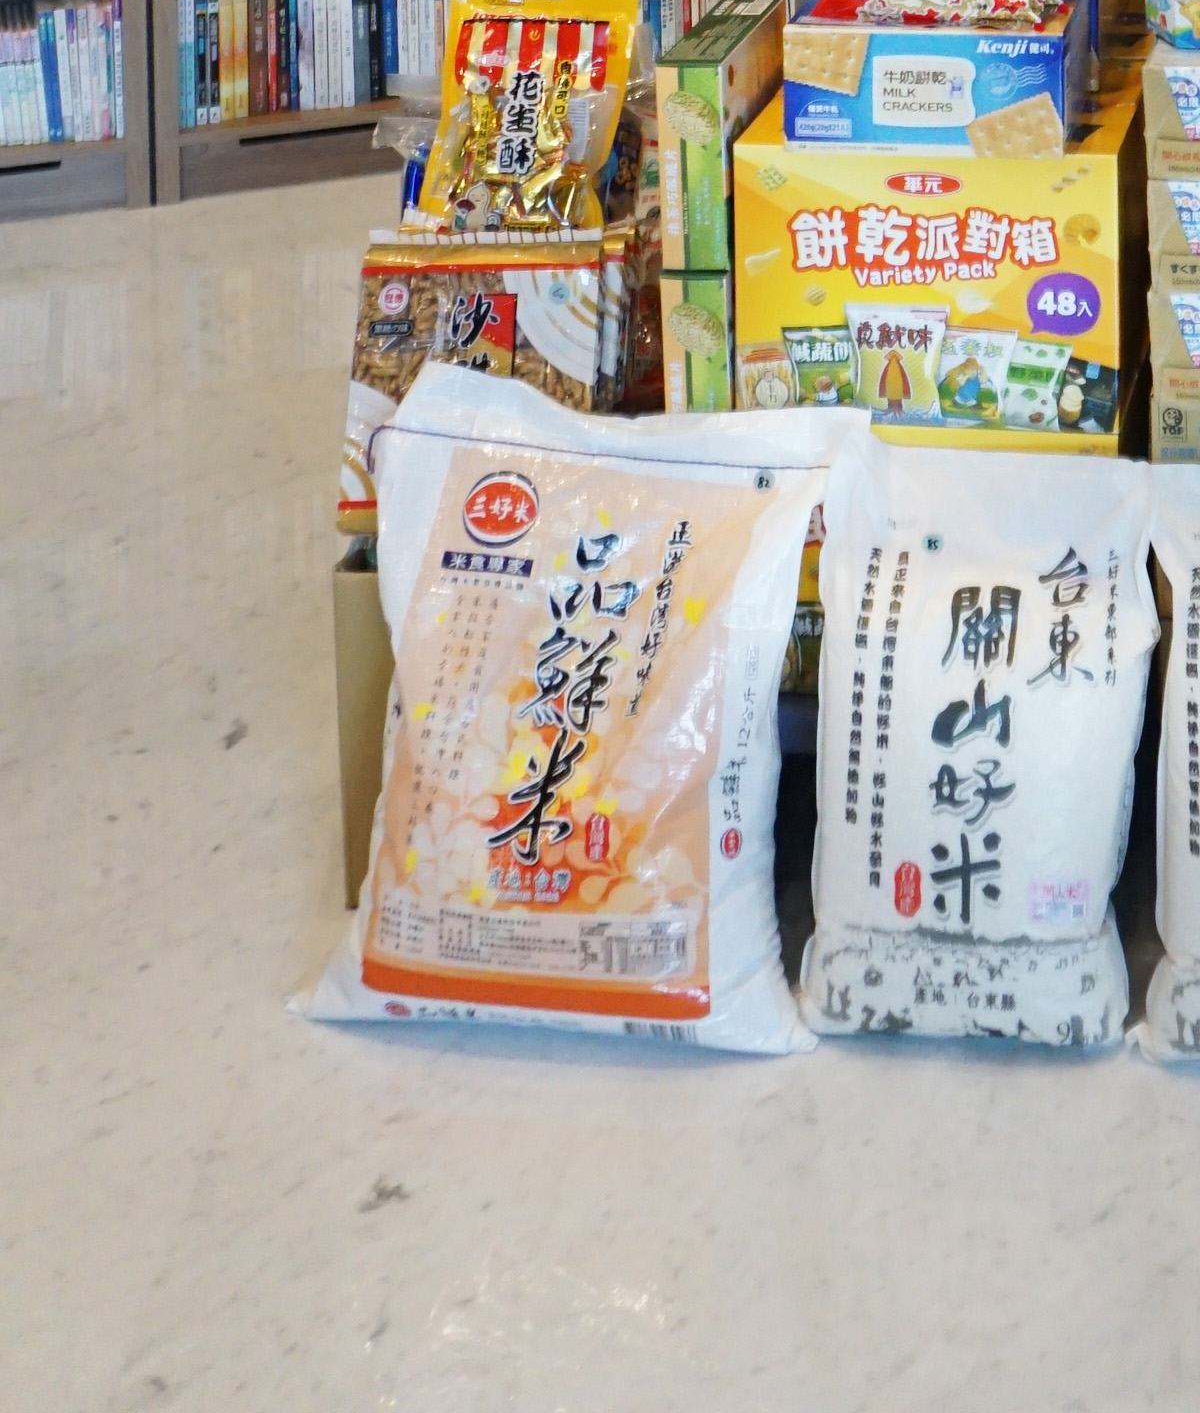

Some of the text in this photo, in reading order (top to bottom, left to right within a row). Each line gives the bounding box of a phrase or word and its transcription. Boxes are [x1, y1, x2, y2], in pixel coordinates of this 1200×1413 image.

[975, 38, 1029, 57] Kenji
[882, 68, 947, 87] 牛奶餅乾
[882, 86, 916, 99] MILK
[882, 100, 953, 114] CRACKERS
[498, 71, 543, 173] 花生酥
[903, 175, 945, 195] 華元
[790, 205, 1058, 270] 餅乾派對箱
[853, 258, 996, 289] Variety Pack
[1036, 290, 1093, 318] 48入
[466, 496, 532, 523] 三好米
[449, 551, 528, 575] 米食專家
[1026, 544, 1096, 687] 台東
[486, 532, 642, 866] 品鮮米
[928, 584, 1022, 925] 關山好米
